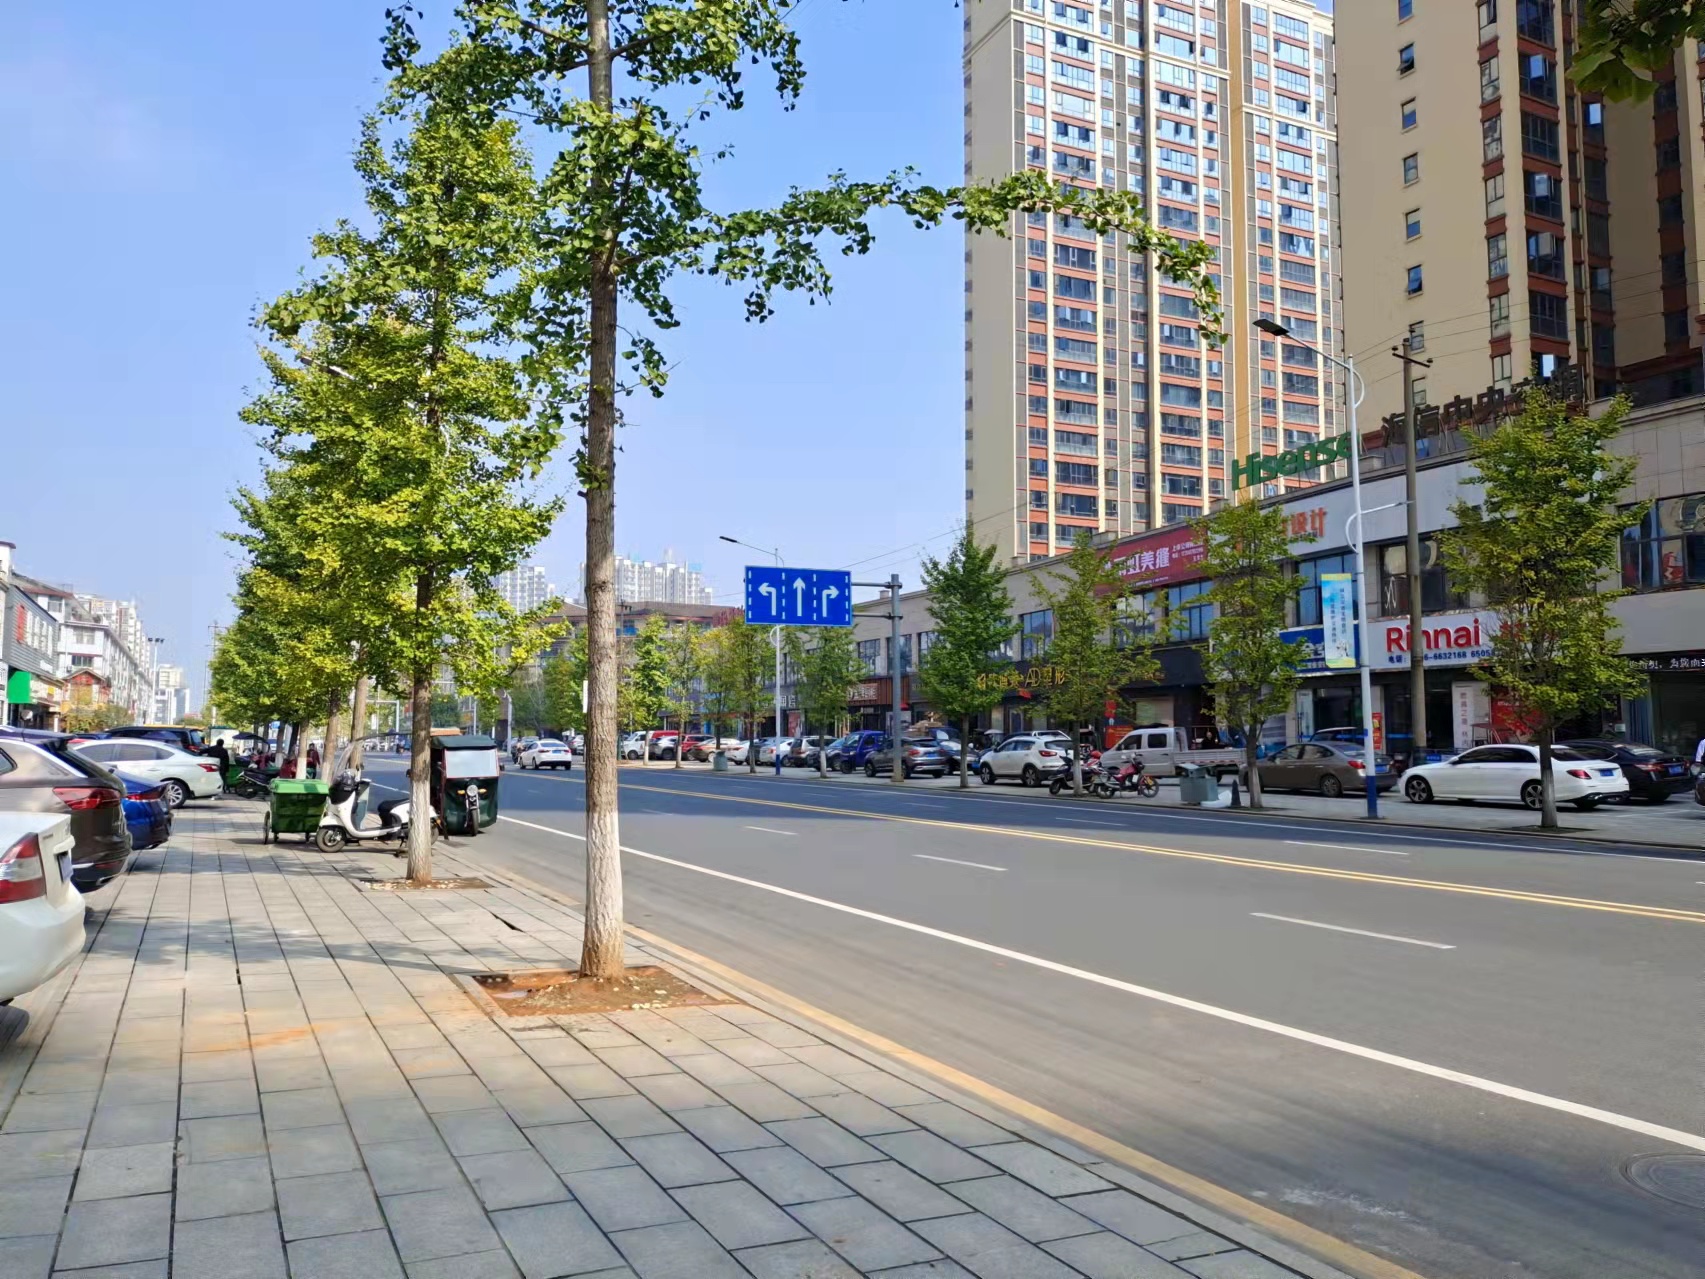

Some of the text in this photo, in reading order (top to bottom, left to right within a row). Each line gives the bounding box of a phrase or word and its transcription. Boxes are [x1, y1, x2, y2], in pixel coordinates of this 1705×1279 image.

[1381, 364, 1584, 448] 海信中央调
[1232, 431, 1361, 491] Hisense
[1386, 617, 1481, 652] Rinnai
